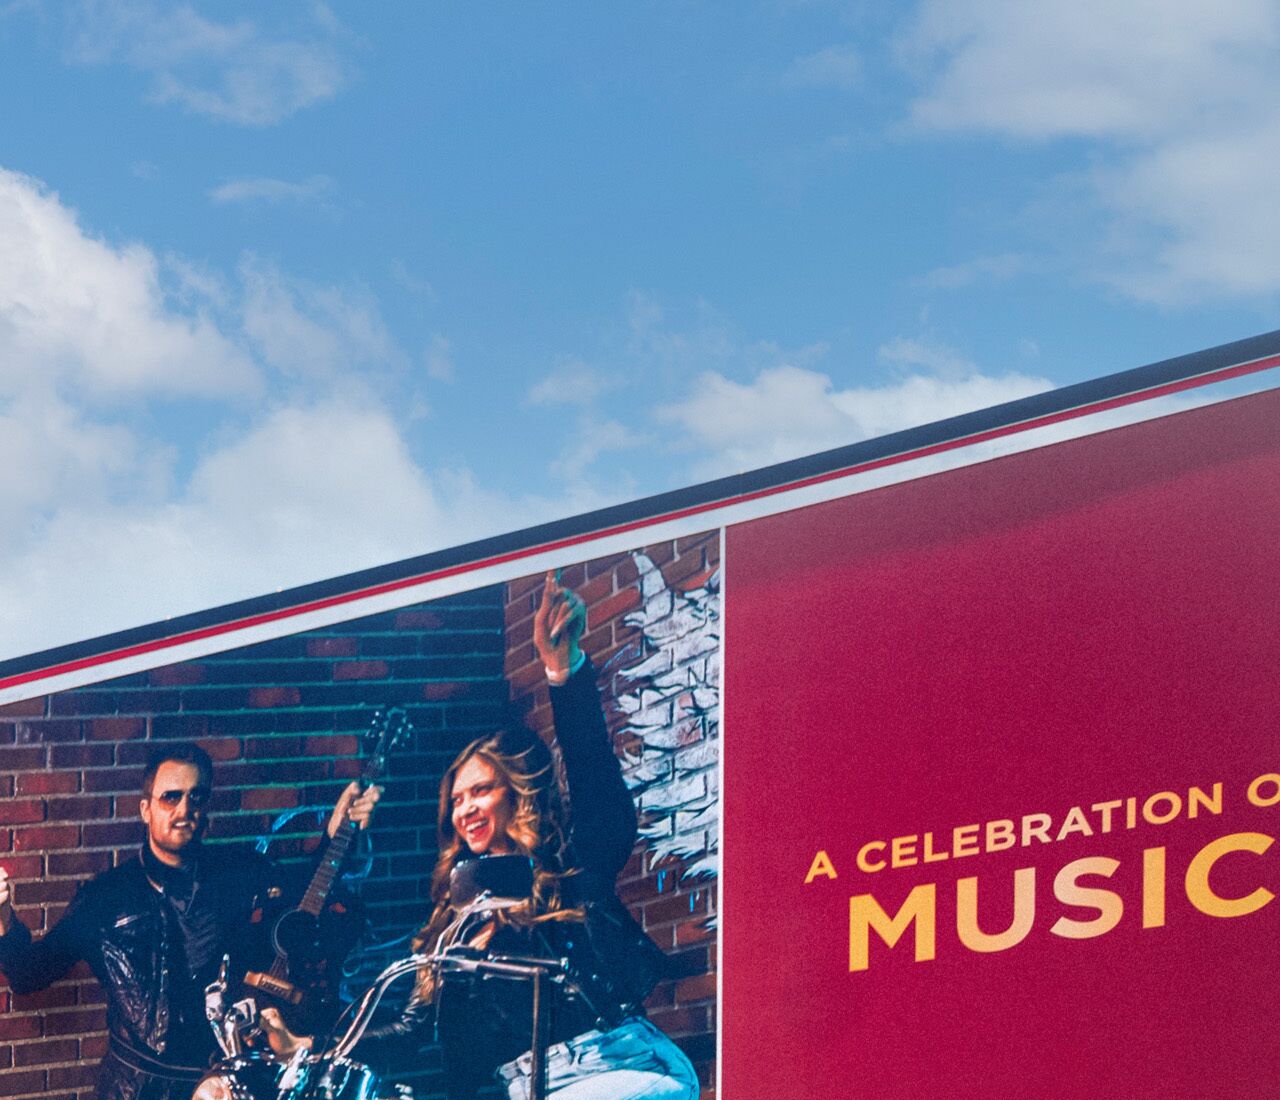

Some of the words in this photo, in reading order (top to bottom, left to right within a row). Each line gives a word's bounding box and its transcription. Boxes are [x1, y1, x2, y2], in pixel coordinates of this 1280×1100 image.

[803, 849, 838, 884] A
[856, 782, 1223, 873] CELEBRATION
[848, 832, 1276, 972] MUSIC
